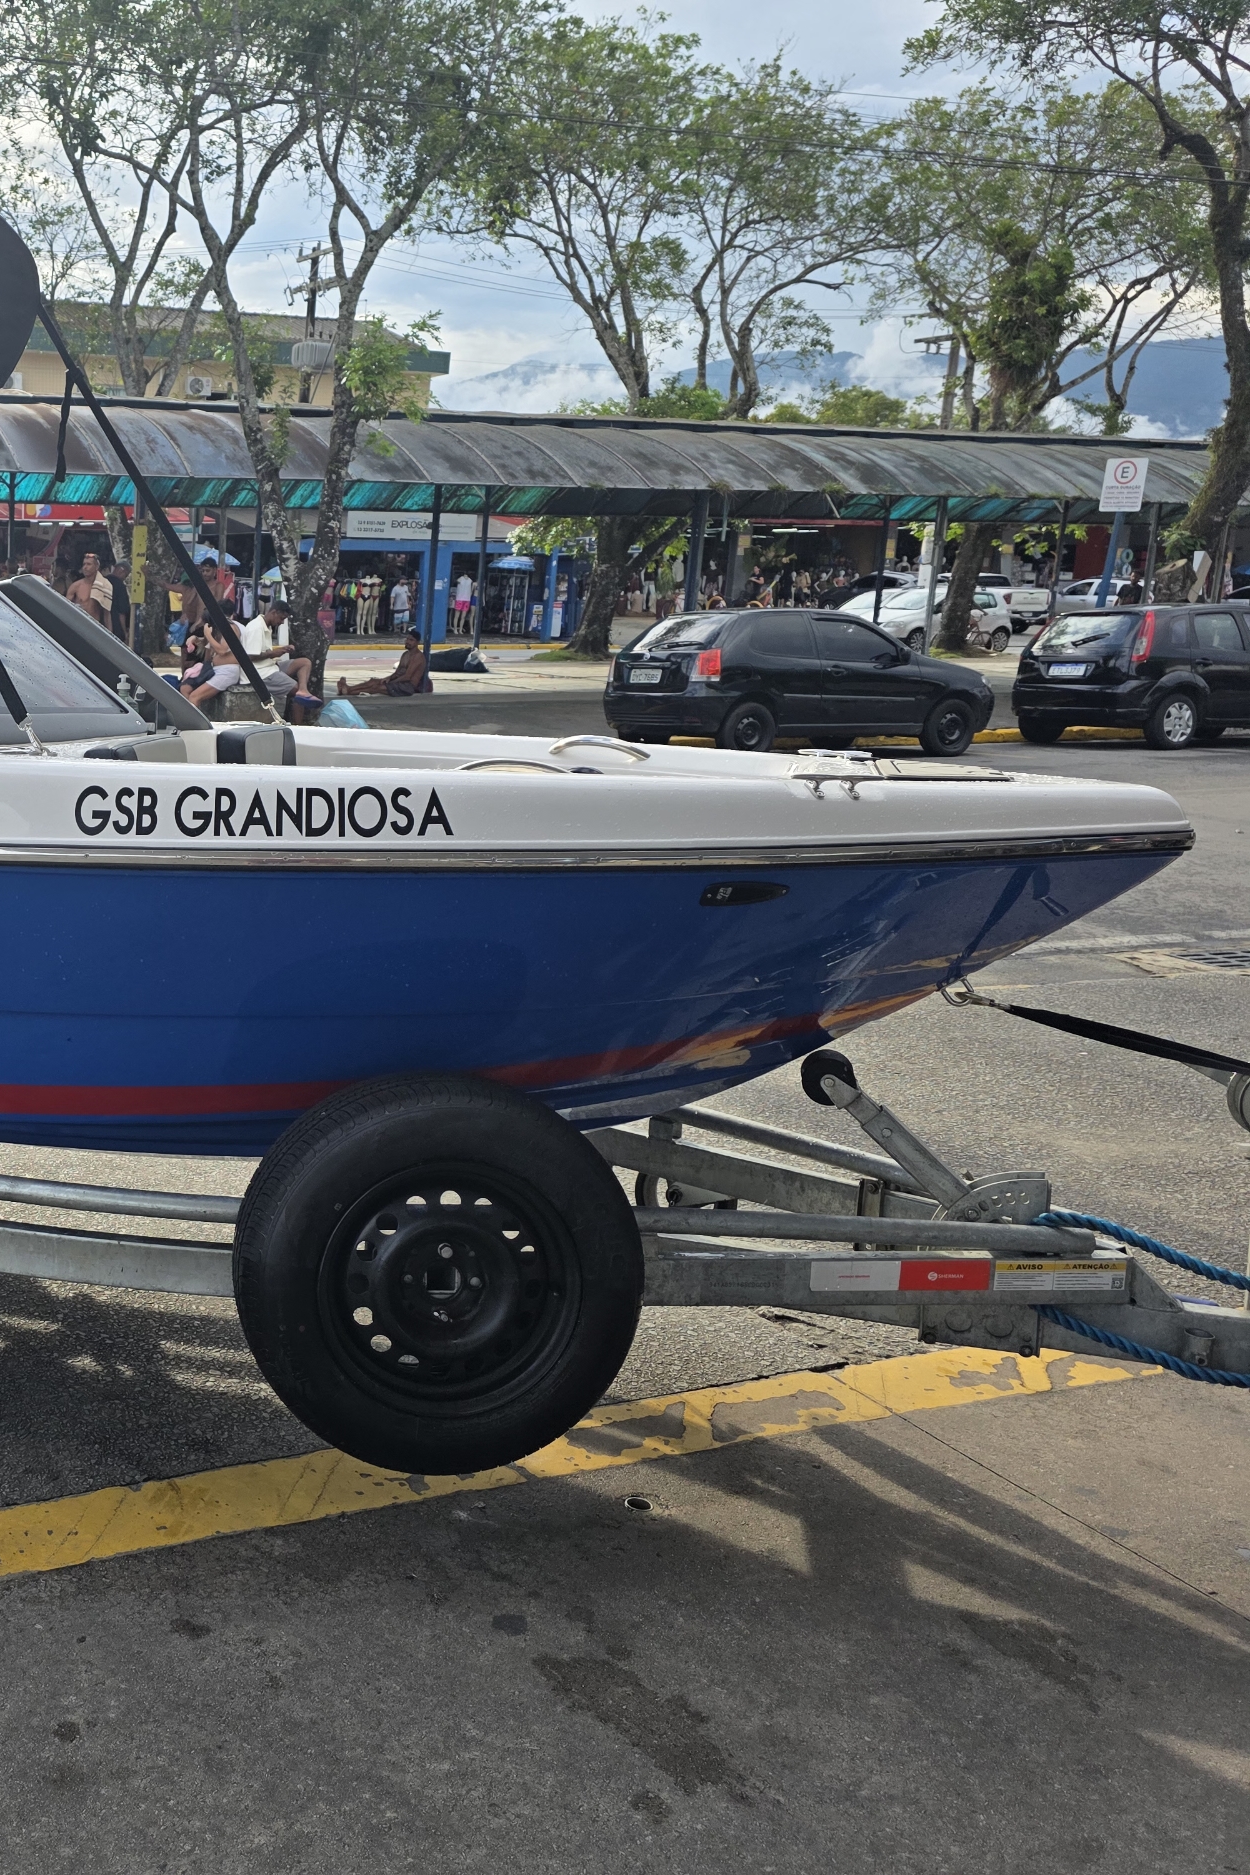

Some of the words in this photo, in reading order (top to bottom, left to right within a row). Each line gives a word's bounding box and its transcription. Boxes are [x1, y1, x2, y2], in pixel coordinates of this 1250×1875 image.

[1121, 466, 1130, 479] E
[75, 785, 159, 836] GSB
[174, 785, 455, 838] GRANDIOSA
[1071, 1262, 1110, 1271] ATENÇÃO
